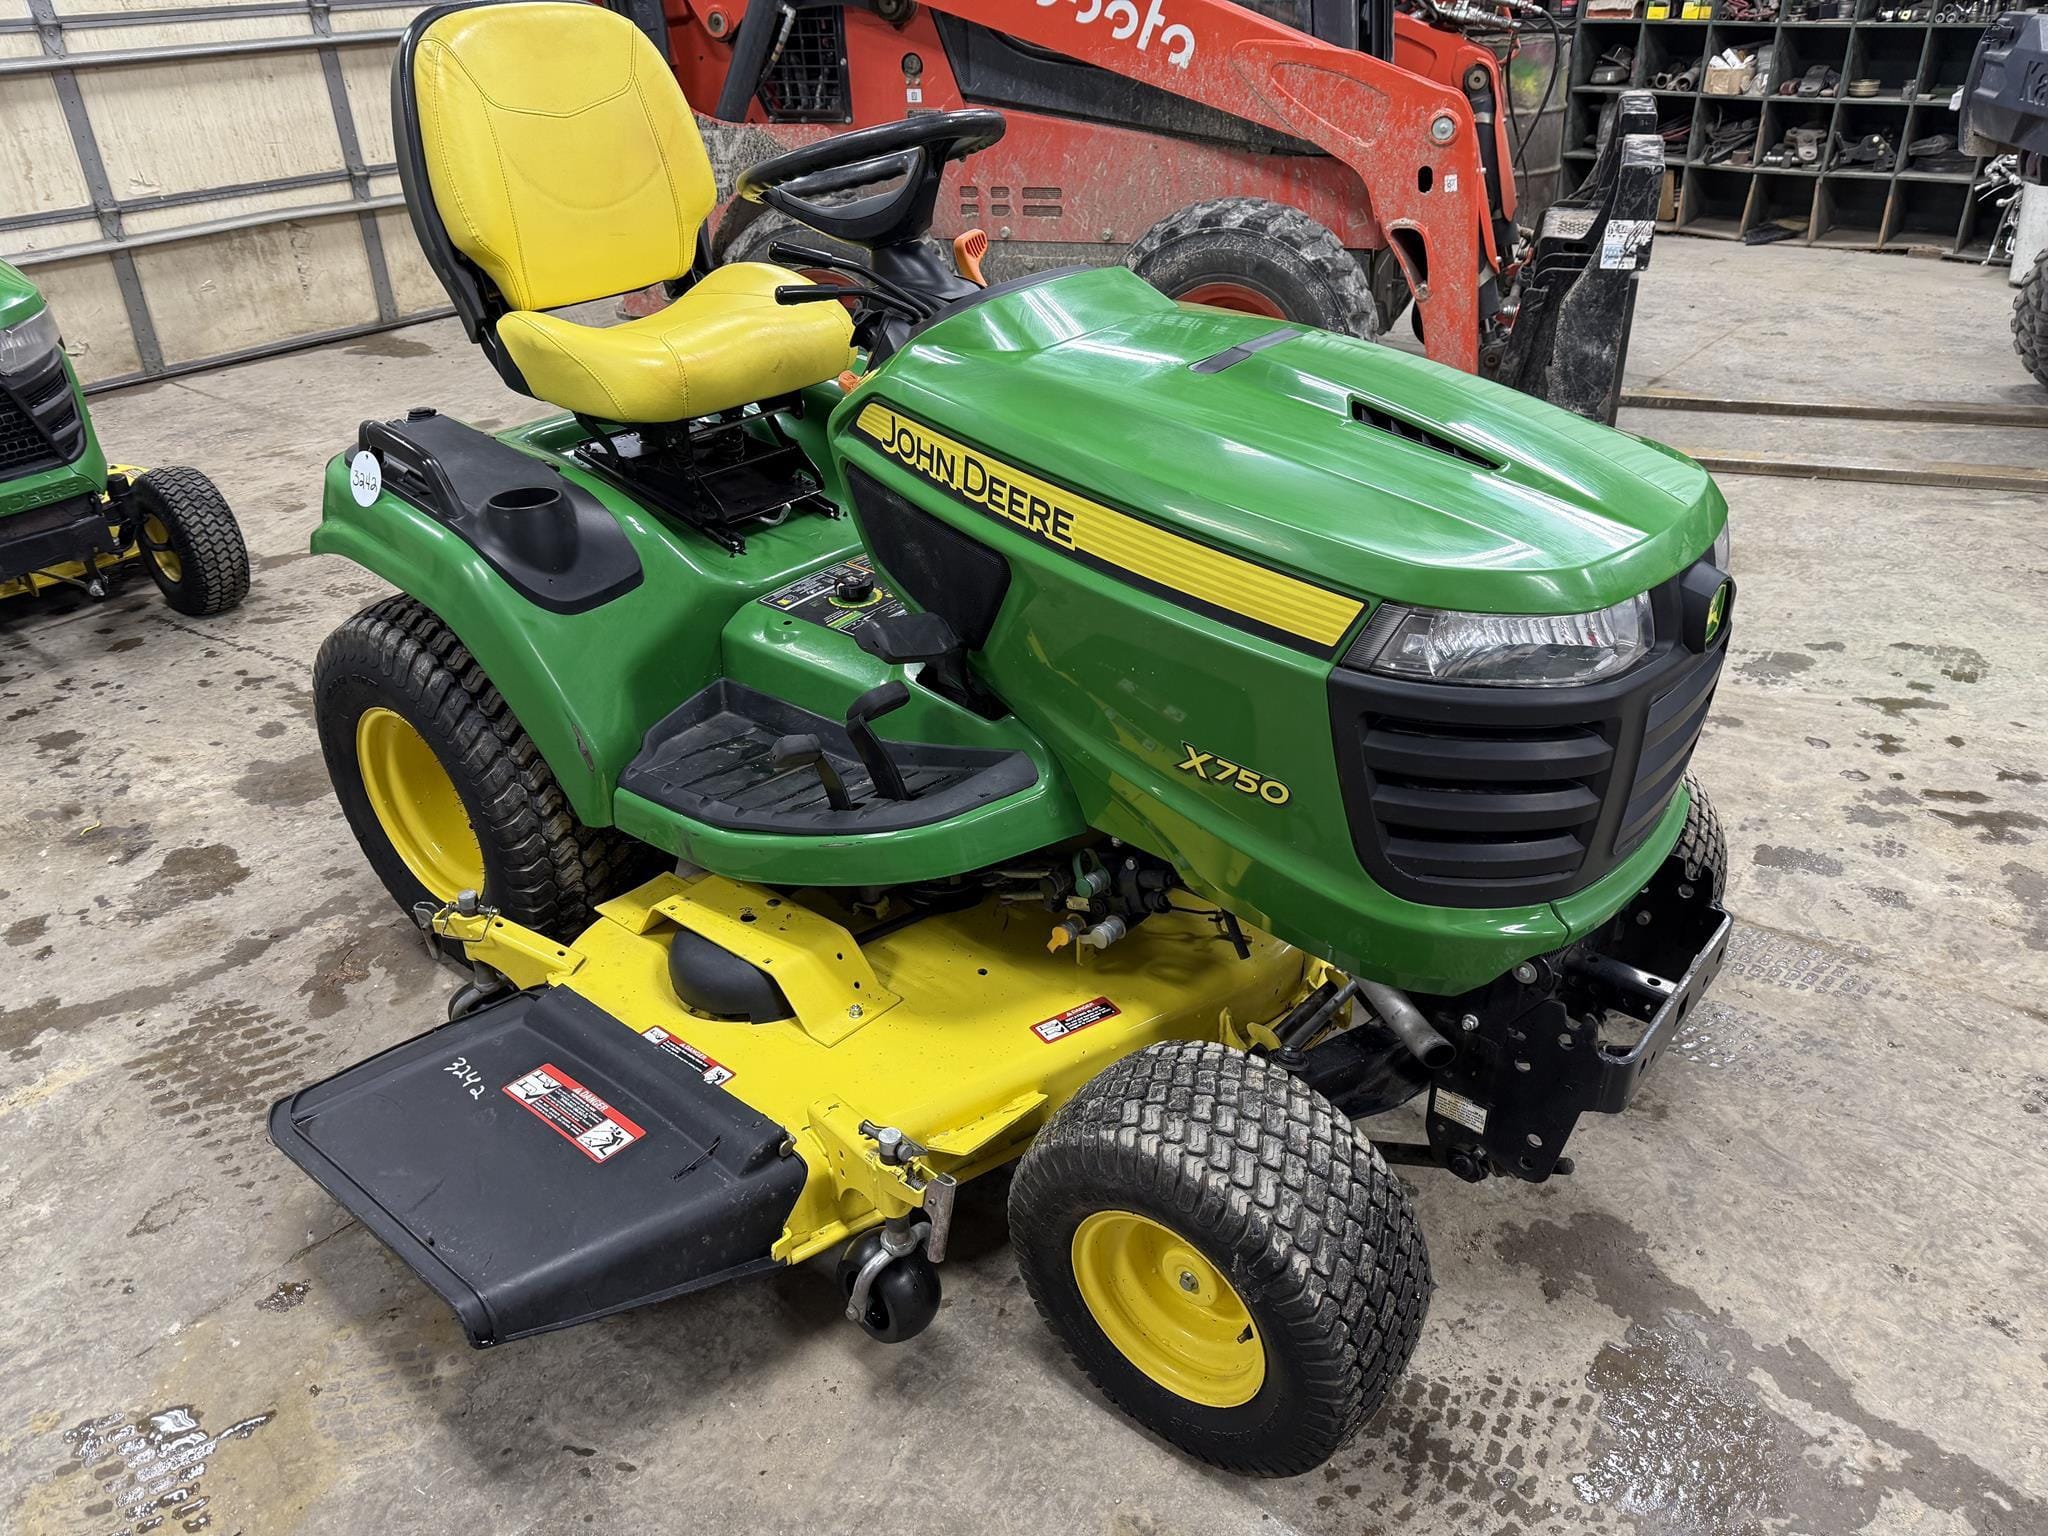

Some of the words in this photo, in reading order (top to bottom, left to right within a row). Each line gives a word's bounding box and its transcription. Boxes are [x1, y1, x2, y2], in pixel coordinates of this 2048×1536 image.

[353, 469, 378, 492] 3242
[882, 415, 957, 485] JOHN
[963, 454, 1075, 546] DEERE
[1176, 742, 1291, 806] X750
[443, 1056, 485, 1100] 3242
[579, 1089, 609, 1112] DANGER
